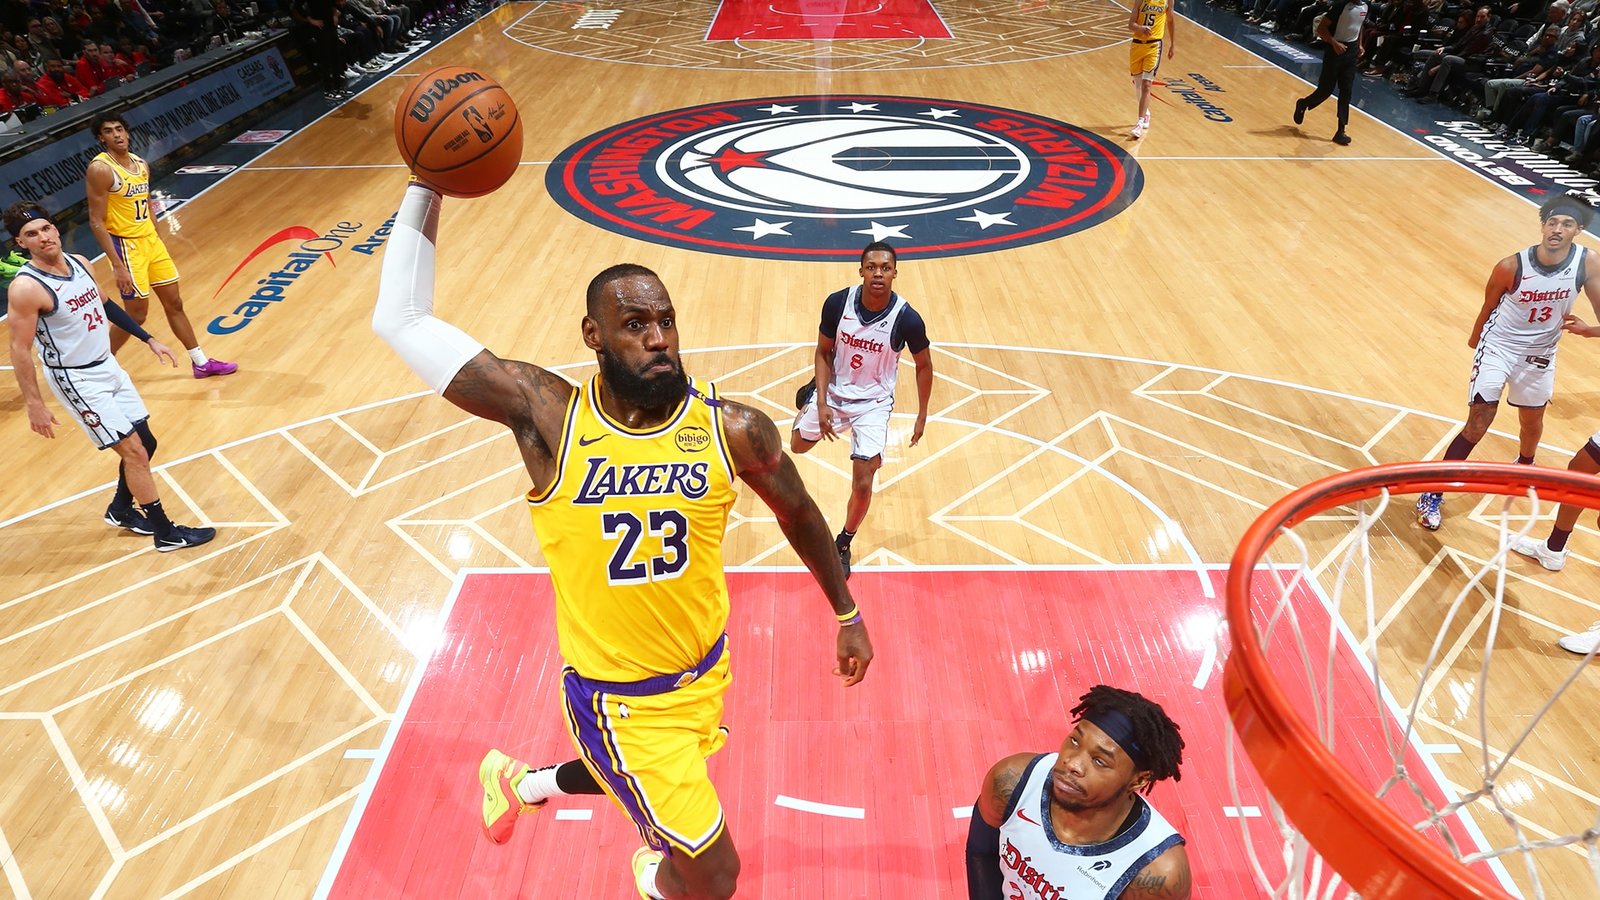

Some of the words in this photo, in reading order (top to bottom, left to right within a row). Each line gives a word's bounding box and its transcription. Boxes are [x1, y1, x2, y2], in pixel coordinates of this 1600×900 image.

[1143, 14, 1156, 26] 15
[237, 60, 265, 80] CAESARS
[409, 72, 486, 122] Wilson
[9, 177, 43, 201] THE
[31, 152, 88, 197] EXCLUSIVE
[129, 121, 156, 151] ETTING
[151, 112, 174, 139] APP
[173, 99, 210, 127] CAPITAL
[201, 90, 224, 115] ONE
[215, 82, 242, 106] ARENA
[588, 111, 743, 231] WASHINGTON
[975, 118, 1098, 209] WIZARDS
[1424, 135, 1535, 186] BEYOND
[135, 199, 148, 222] 12
[65, 286, 98, 313] District
[1519, 287, 1571, 303] District
[83, 307, 103, 333] 24
[1528, 306, 1553, 323] 13
[840, 330, 884, 353] District
[850, 354, 863, 370] 8
[678, 433, 709, 445] bibigo
[572, 456, 710, 505] LAKERS
[602, 509, 691, 586] 23
[1001, 837, 1069, 900] Distri
[1077, 865, 1107, 891] Robinhood
